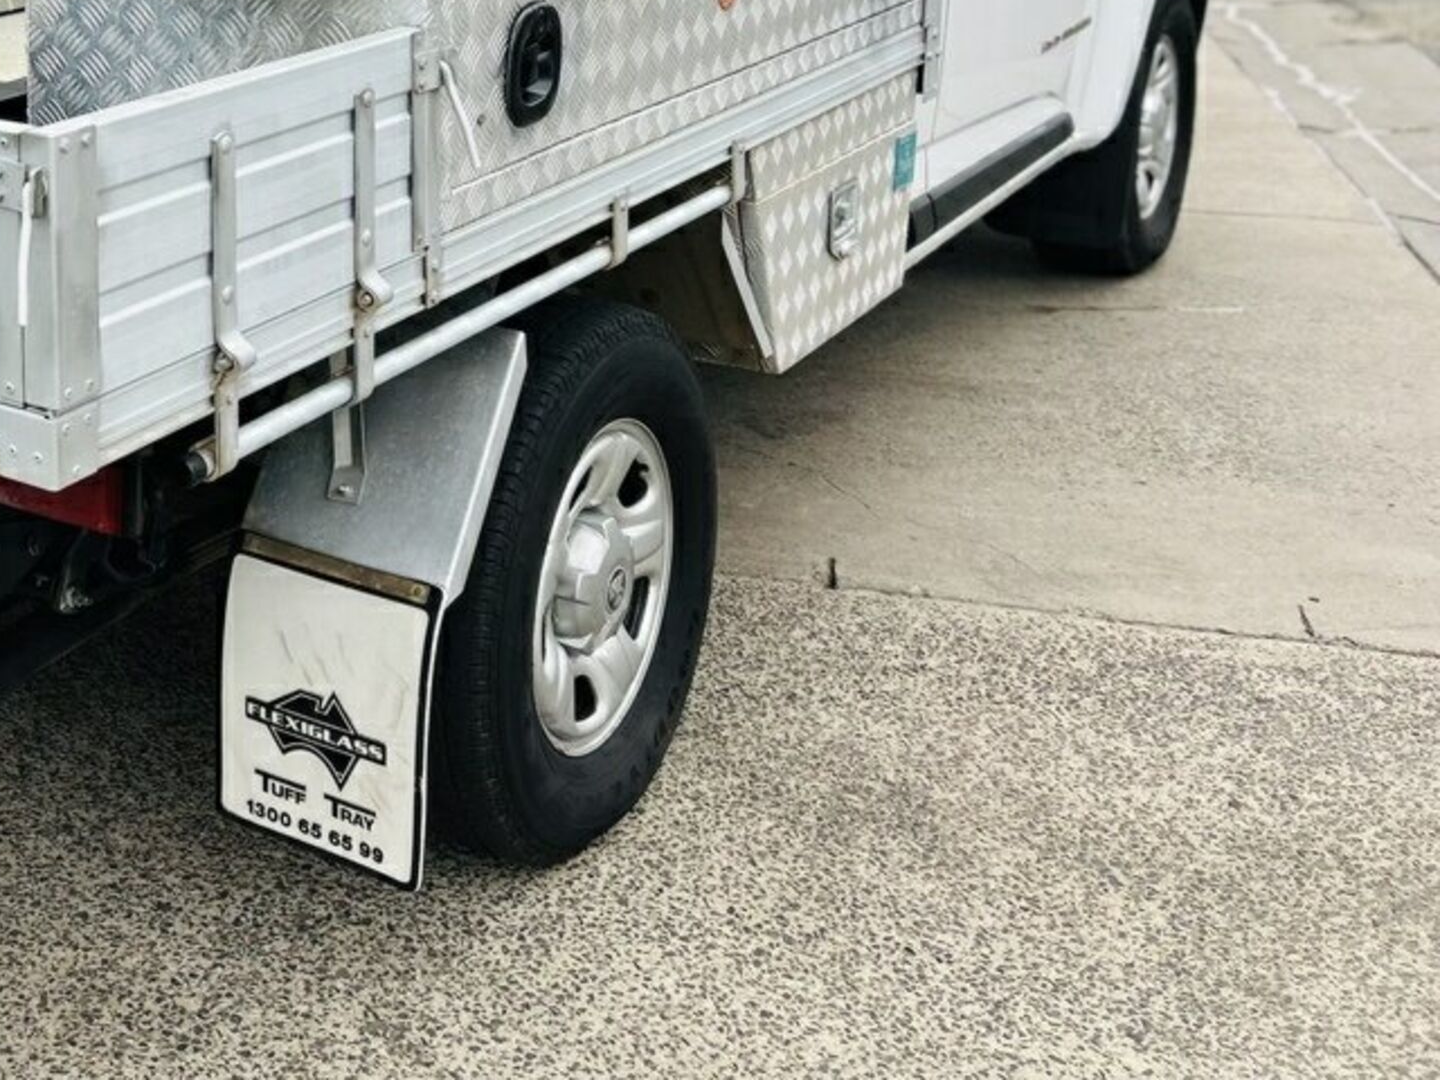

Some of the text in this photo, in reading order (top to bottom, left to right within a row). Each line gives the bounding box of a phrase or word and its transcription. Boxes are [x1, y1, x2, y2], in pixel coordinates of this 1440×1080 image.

[246, 702, 384, 761] FLEXIGLASS
[247, 799, 384, 863] 1300 65 65 99
[254, 768, 376, 832] TUFF TRAY
